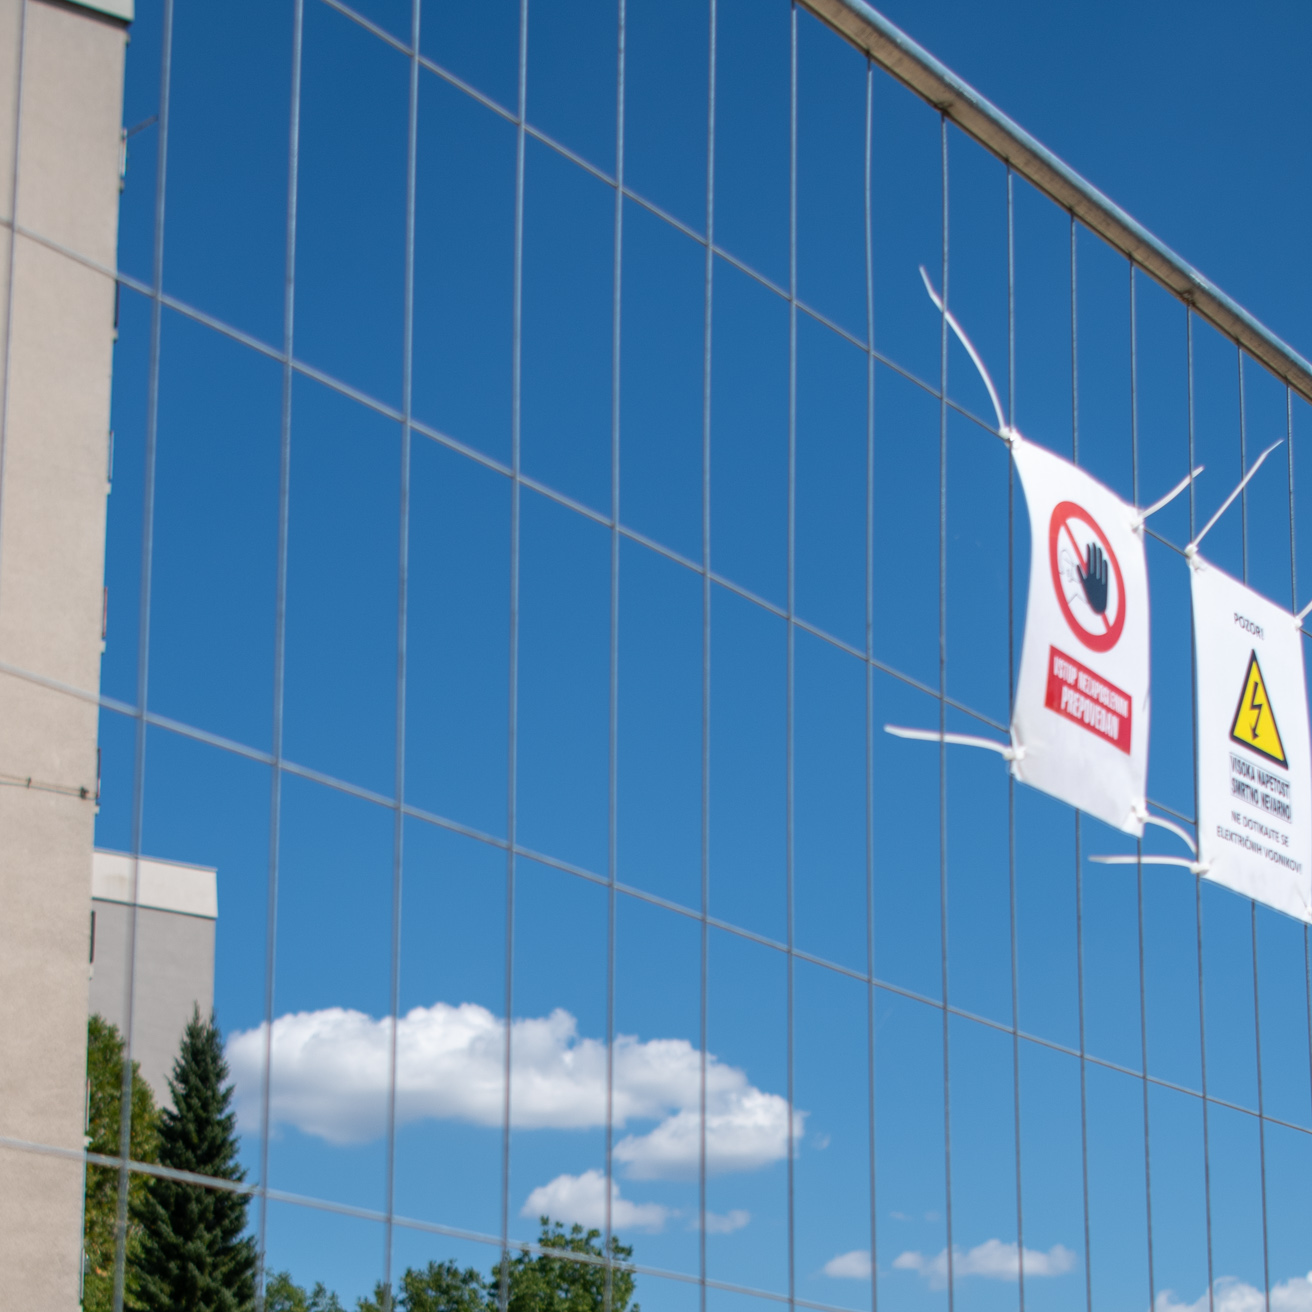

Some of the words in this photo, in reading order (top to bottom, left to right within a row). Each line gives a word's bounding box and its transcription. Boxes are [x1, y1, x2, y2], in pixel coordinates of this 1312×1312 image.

[1234, 612, 1264, 641] POZOR!
[1060, 685, 1119, 740] PREPOVEDAN
[1230, 756, 1255, 781] VISOKA
[1257, 769, 1290, 799] NAPETOST
[1231, 777, 1258, 804] SMRTNO
[1260, 792, 1291, 820] NEVARNO
[1216, 825, 1262, 855] ELEKTRIČNIH
[1231, 810, 1241, 825] NE
[1242, 816, 1279, 843] DOTIKAJTE
[1281, 834, 1290, 848] SE
